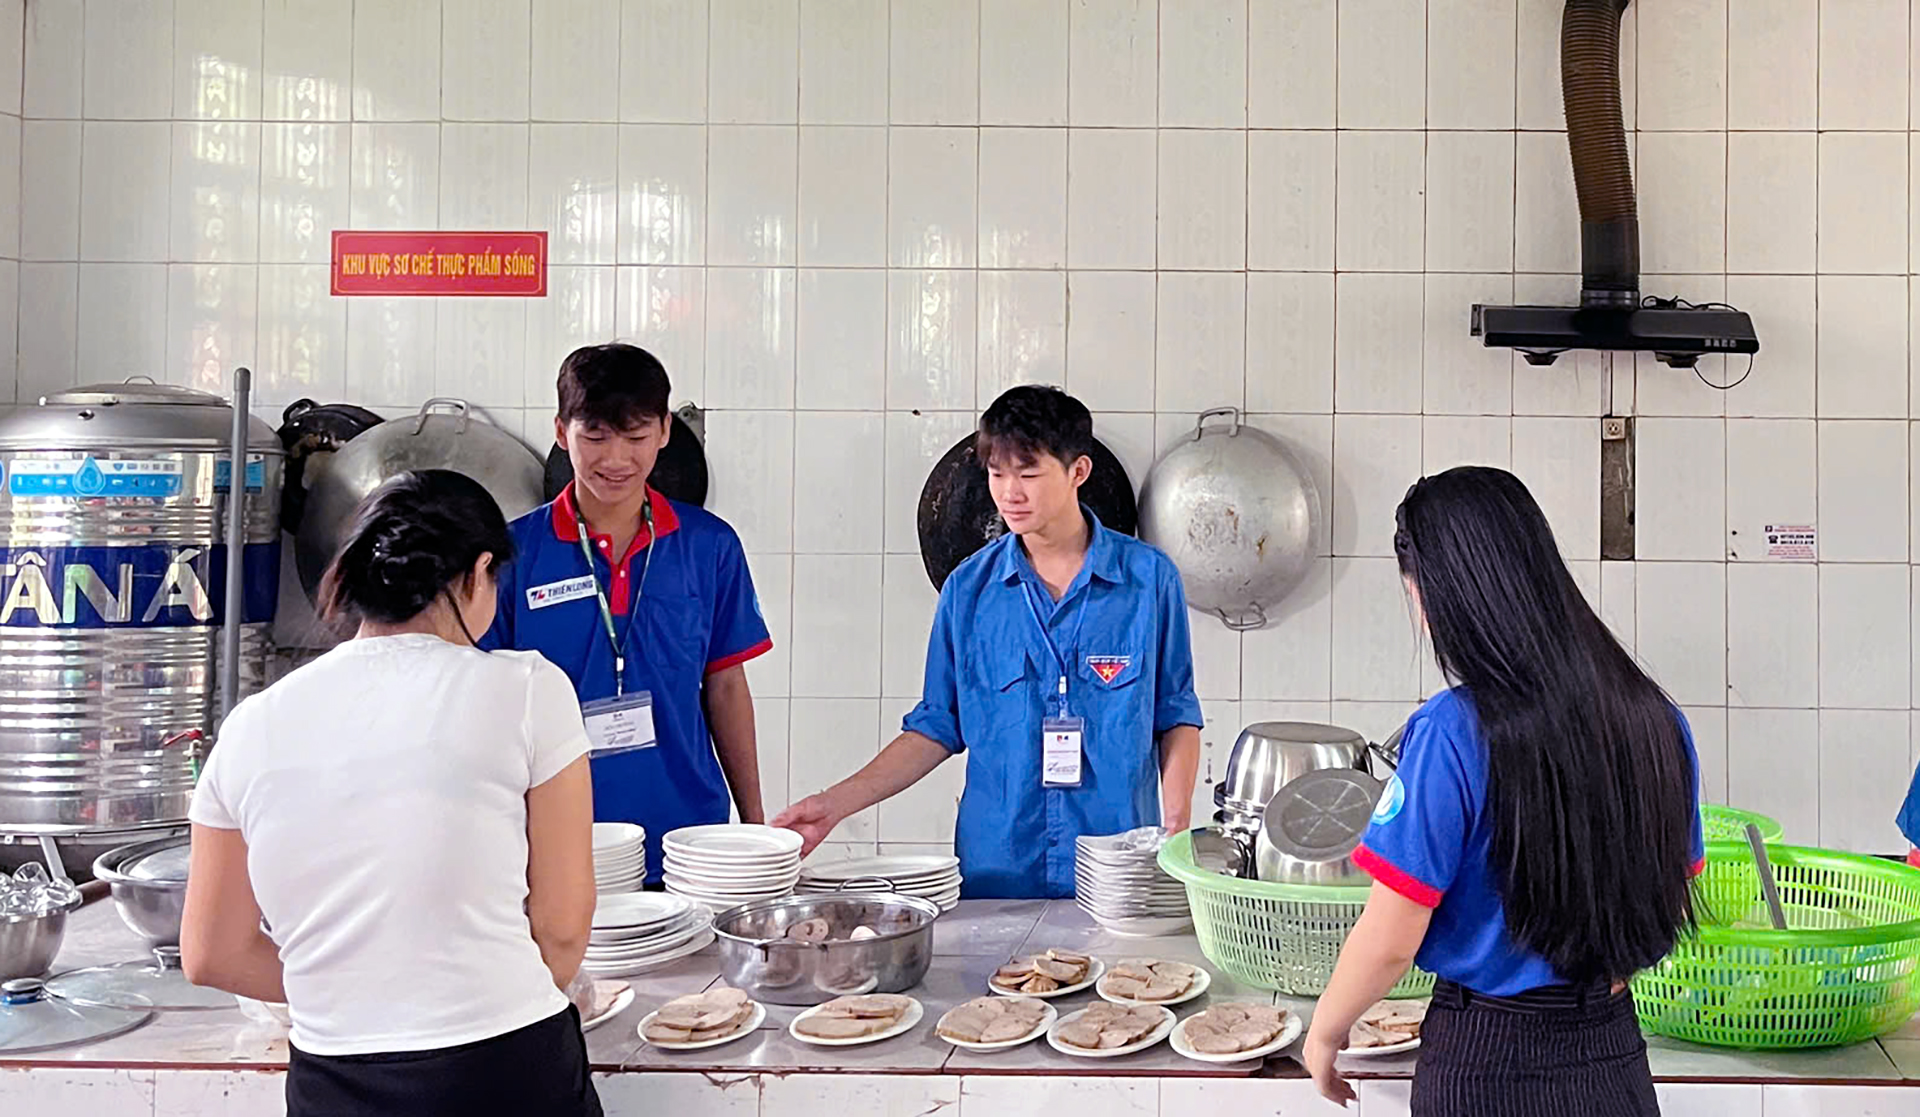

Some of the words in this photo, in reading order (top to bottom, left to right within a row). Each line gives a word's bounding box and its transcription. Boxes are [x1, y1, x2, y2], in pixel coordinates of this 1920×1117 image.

[343, 253, 366, 275] KHU
[368, 252, 391, 280] VỰC
[394, 252, 410, 275] SƠ
[412, 246, 435, 275] CHẾ
[436, 252, 465, 280] THỰC
[504, 246, 535, 275] SỐNG
